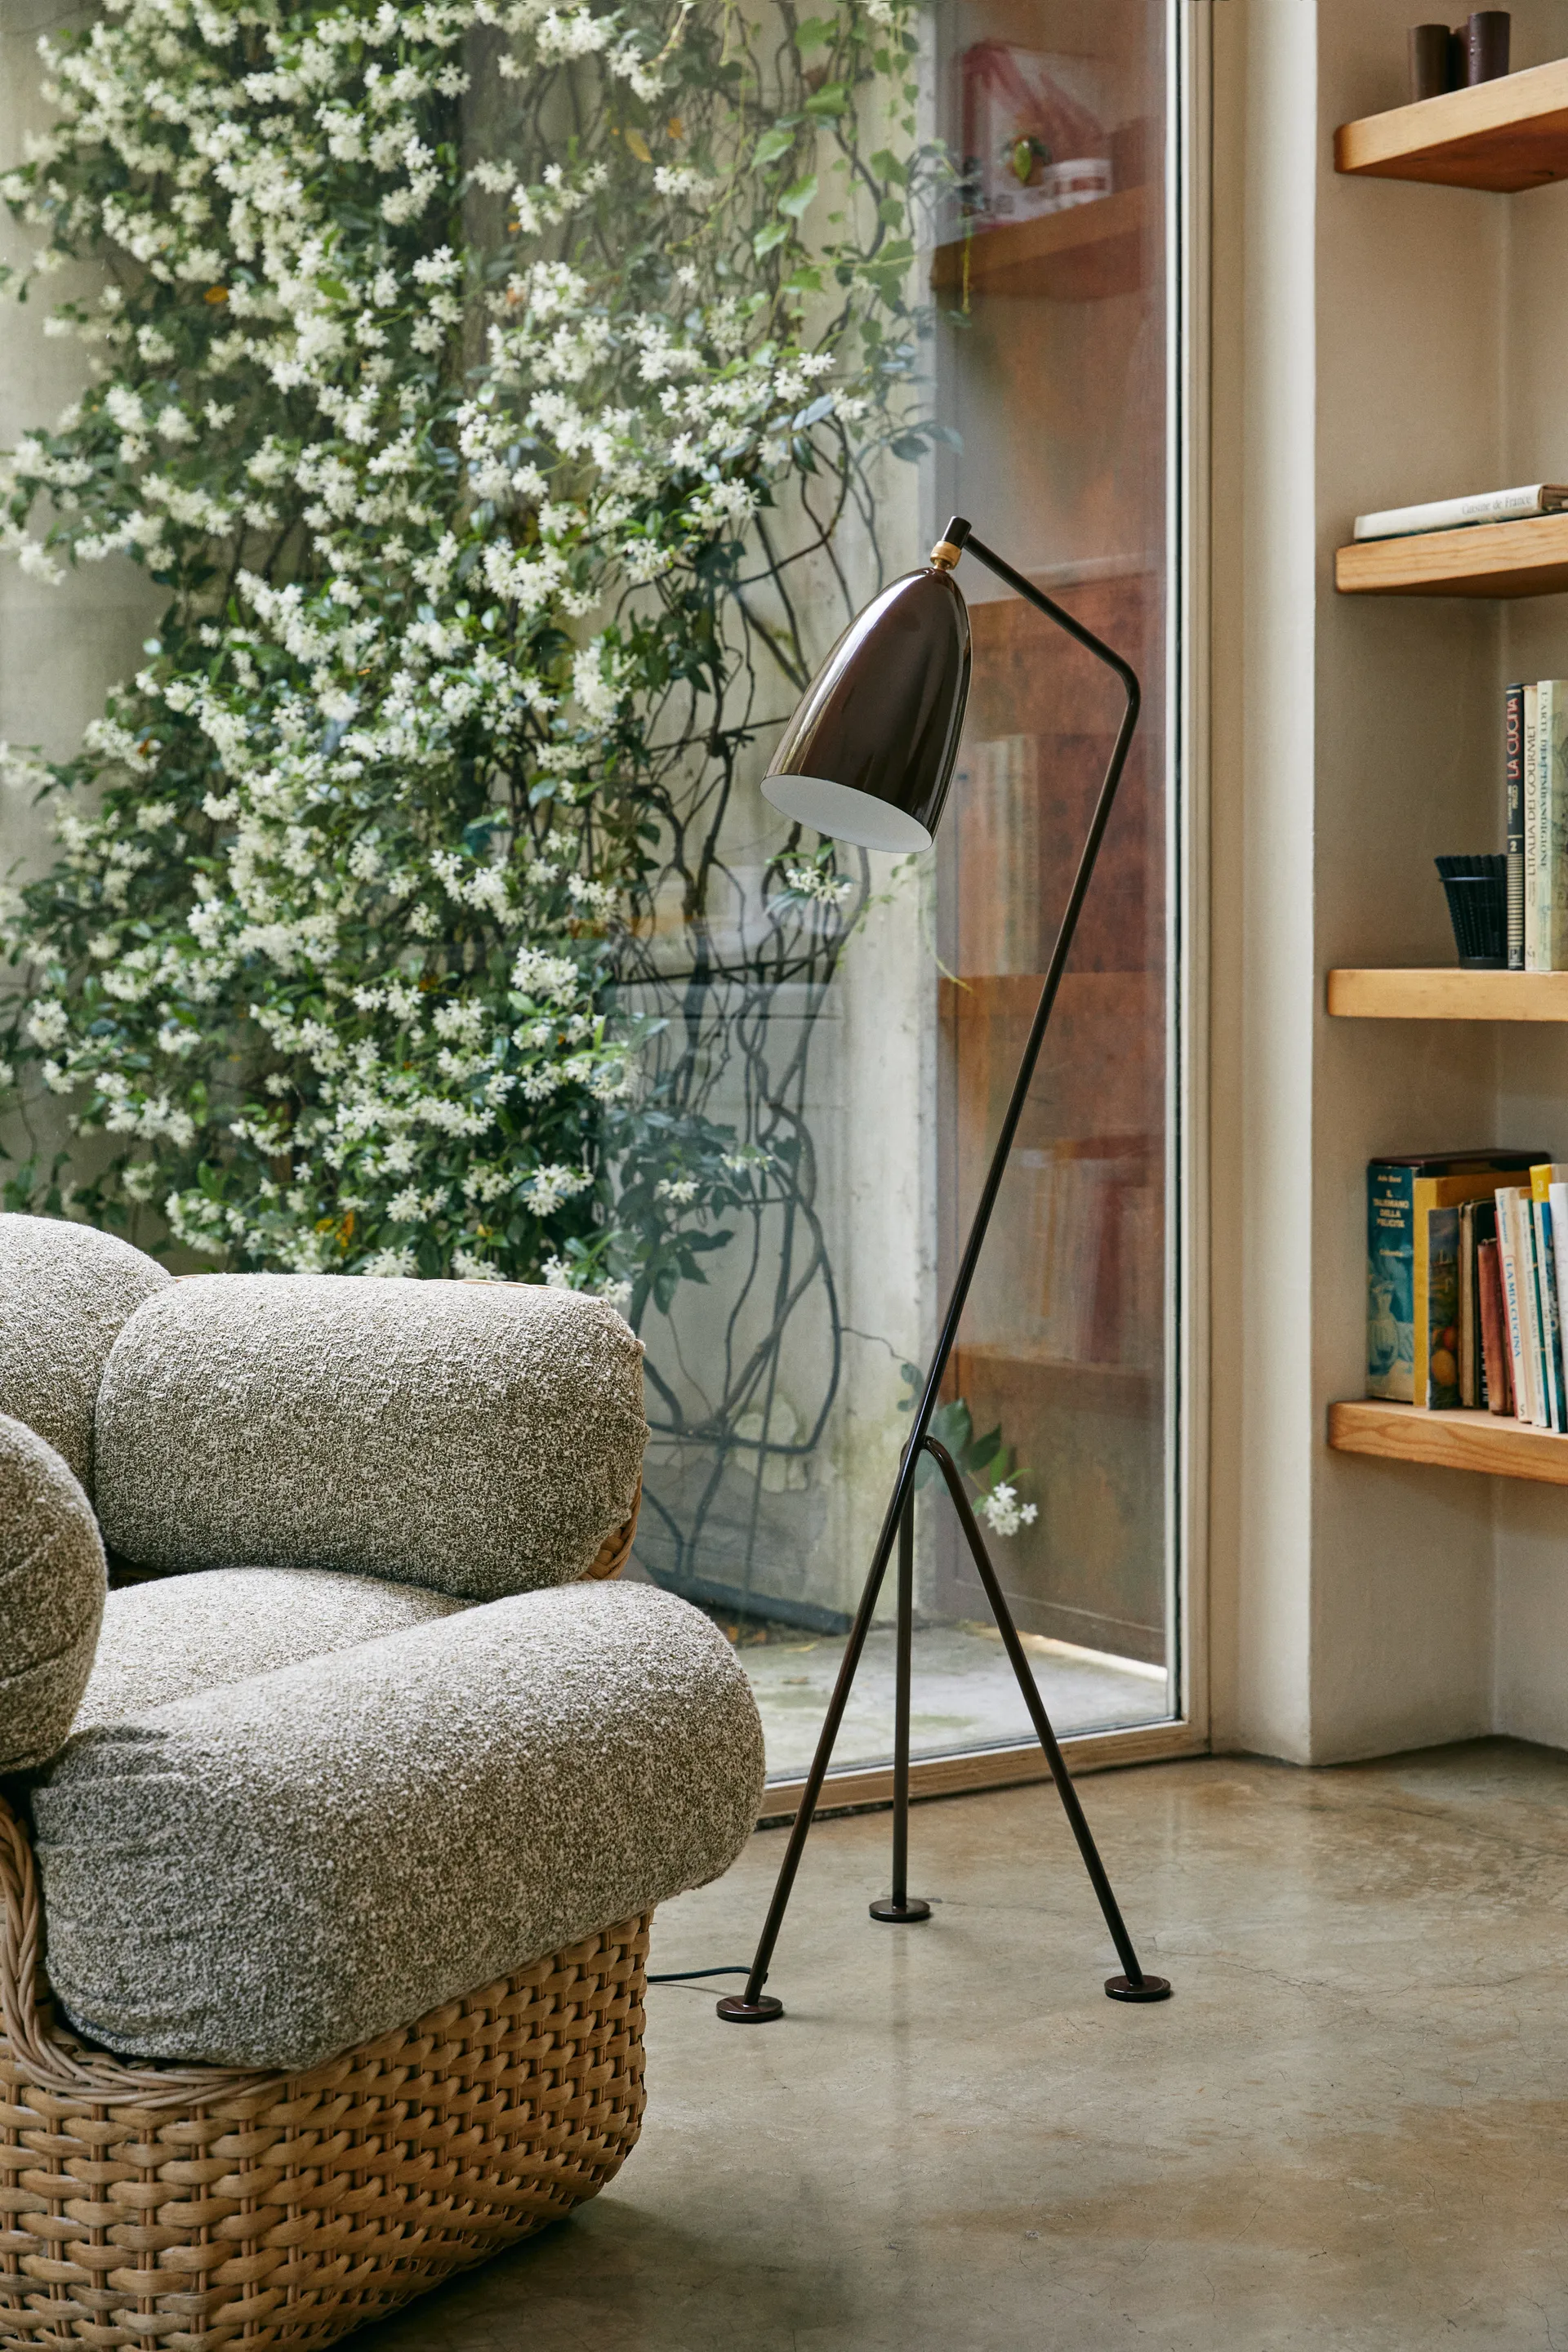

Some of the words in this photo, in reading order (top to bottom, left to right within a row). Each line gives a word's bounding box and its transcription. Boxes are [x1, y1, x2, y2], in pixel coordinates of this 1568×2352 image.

[1504, 495, 1533, 508] France
[1506, 697, 1519, 755] CUCINA
[1507, 760, 1520, 779] LA
[1526, 725, 1535, 795] GOURMET
[1527, 800, 1535, 821] DEI
[1510, 840, 1517, 852] 2
[1505, 1263, 1514, 1280] LA
[1511, 1308, 1521, 1358] CUCINA
